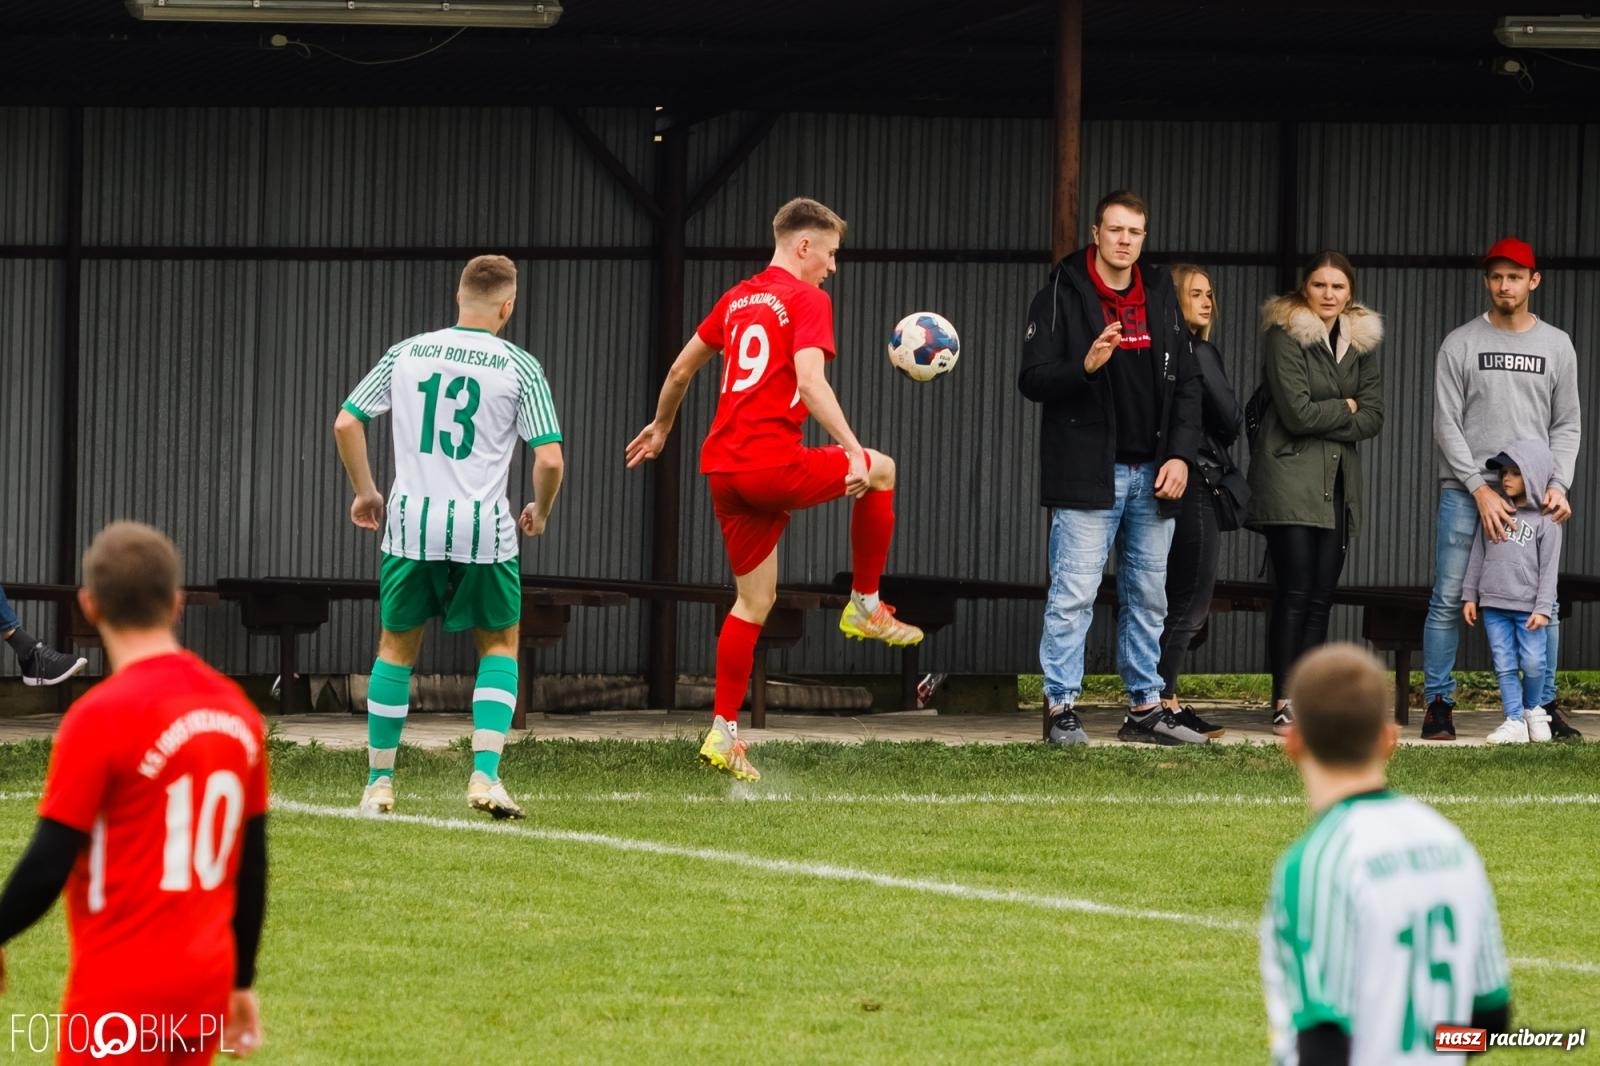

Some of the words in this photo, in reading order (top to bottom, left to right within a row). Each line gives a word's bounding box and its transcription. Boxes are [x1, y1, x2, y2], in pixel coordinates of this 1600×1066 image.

[729, 296, 749, 314] 1905
[410, 344, 442, 358] RUCH
[445, 347, 509, 371] BOLESŁAW
[722, 323, 770, 394] 19
[417, 372, 481, 460] 13
[160, 769, 245, 891] 10
